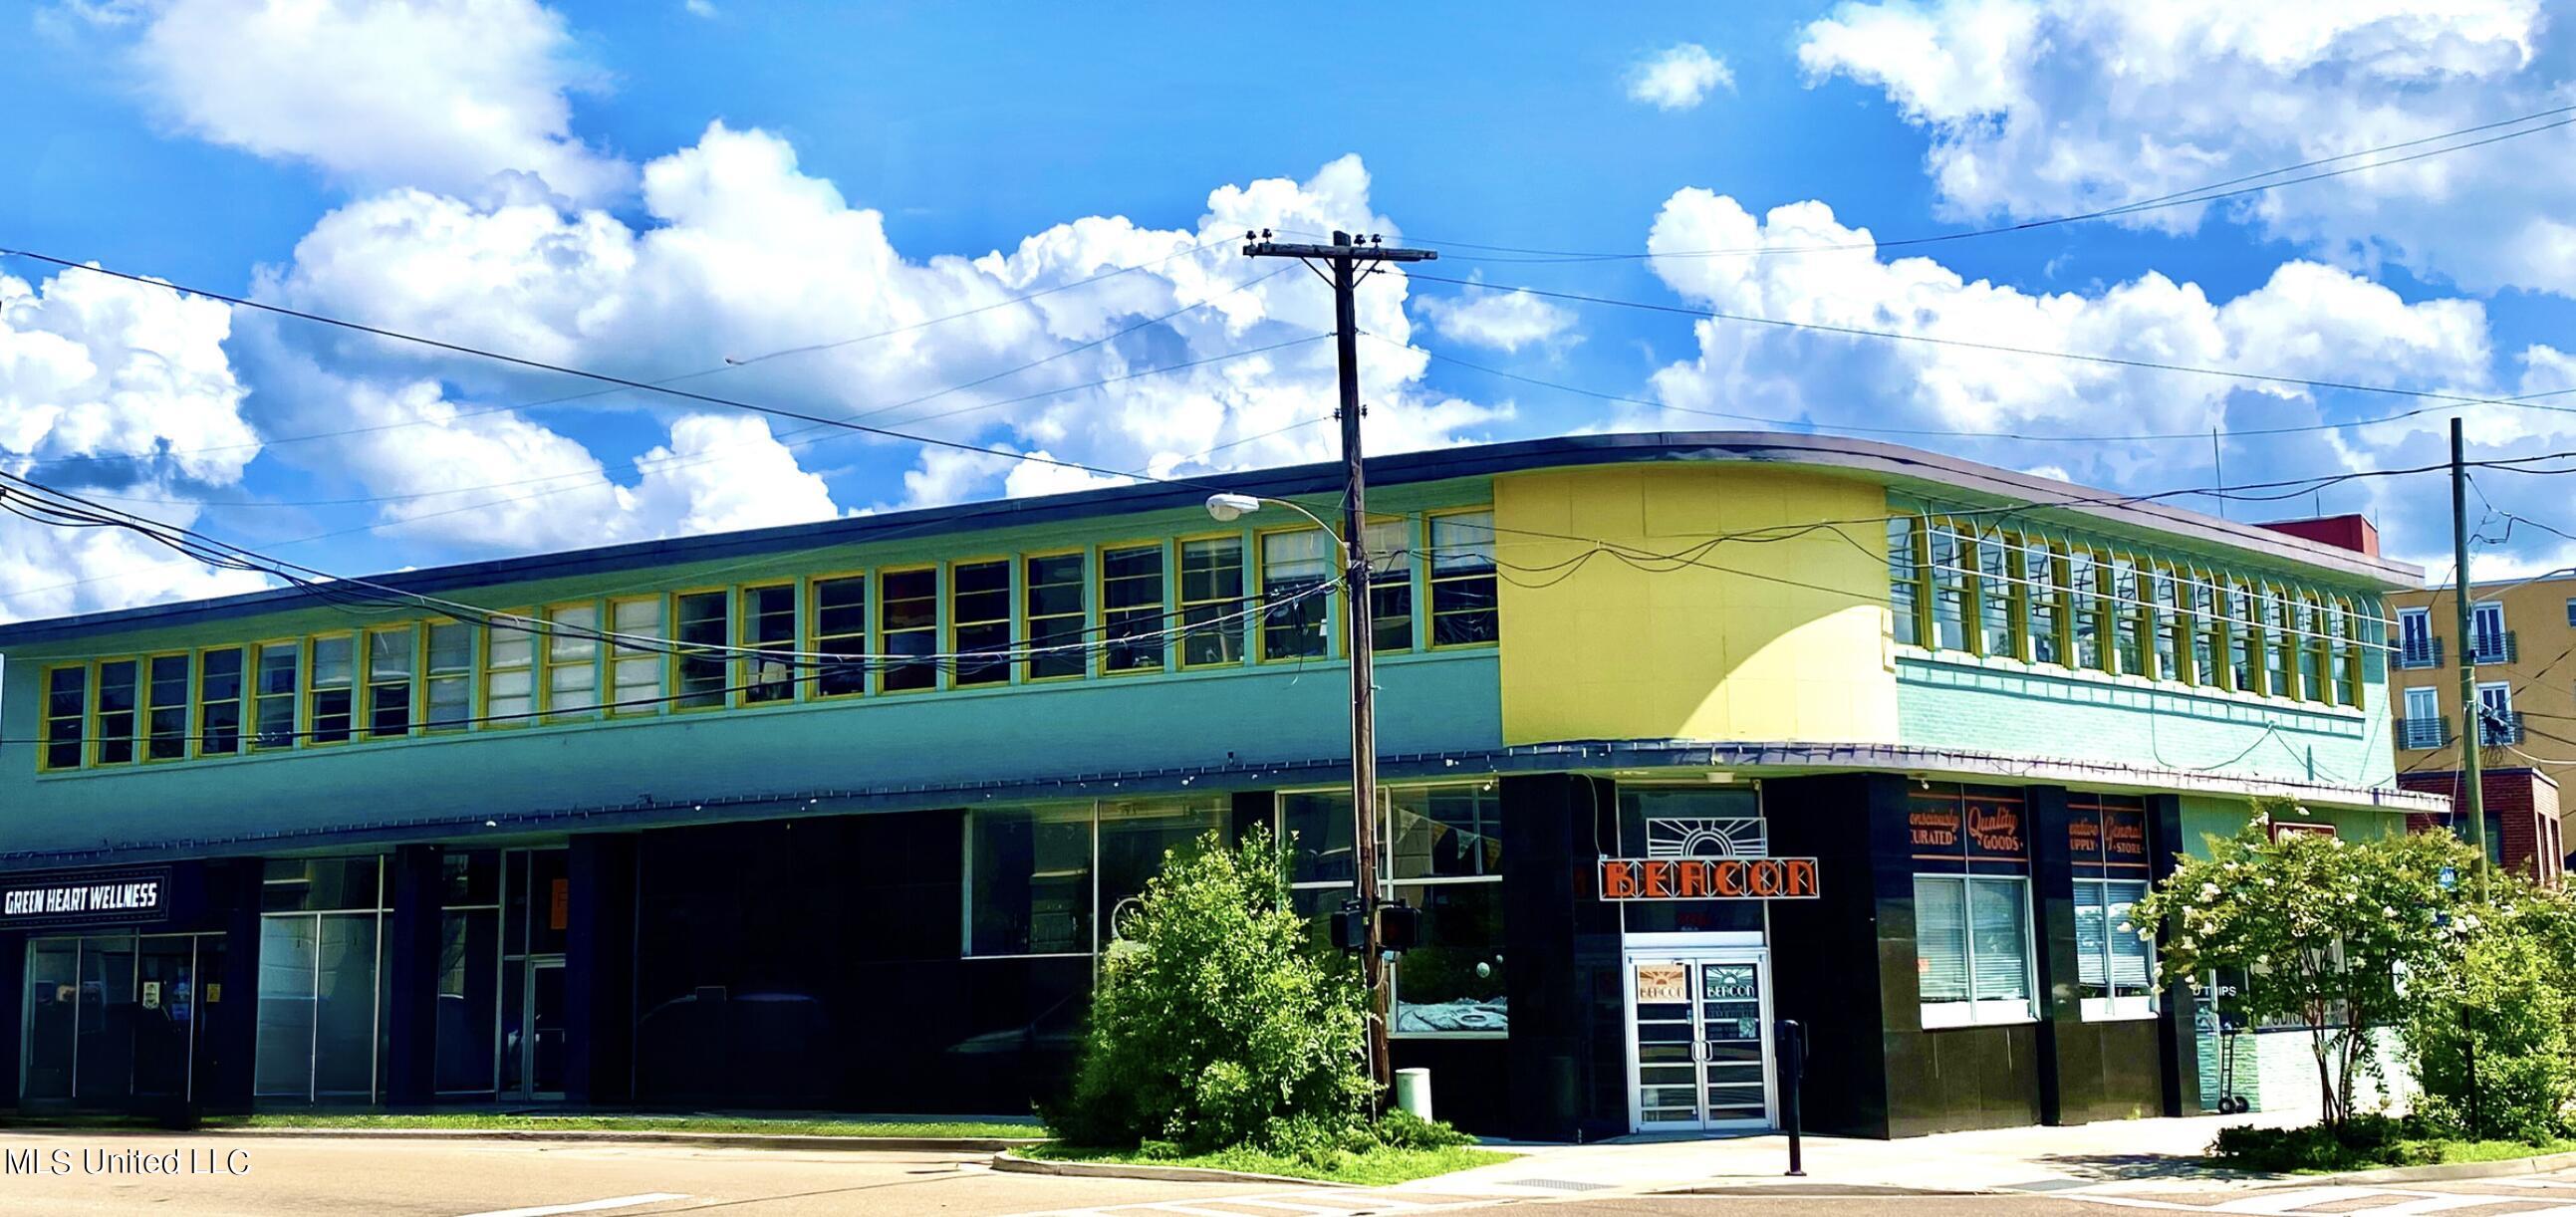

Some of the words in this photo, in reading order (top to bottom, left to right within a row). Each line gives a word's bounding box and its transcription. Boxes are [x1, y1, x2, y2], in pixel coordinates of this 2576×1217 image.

[1909, 809, 1960, 833] onsciously
[1967, 806, 2017, 838] Quality
[1983, 835, 2019, 852] GOODS
[2116, 842, 2143, 854] STORE
[1605, 860, 1816, 897] BEACON
[4, 888, 45, 915] GREEN
[46, 886, 88, 912] HEART
[90, 882, 157, 910] WELLNESS
[1706, 985, 1754, 998] BEACON
